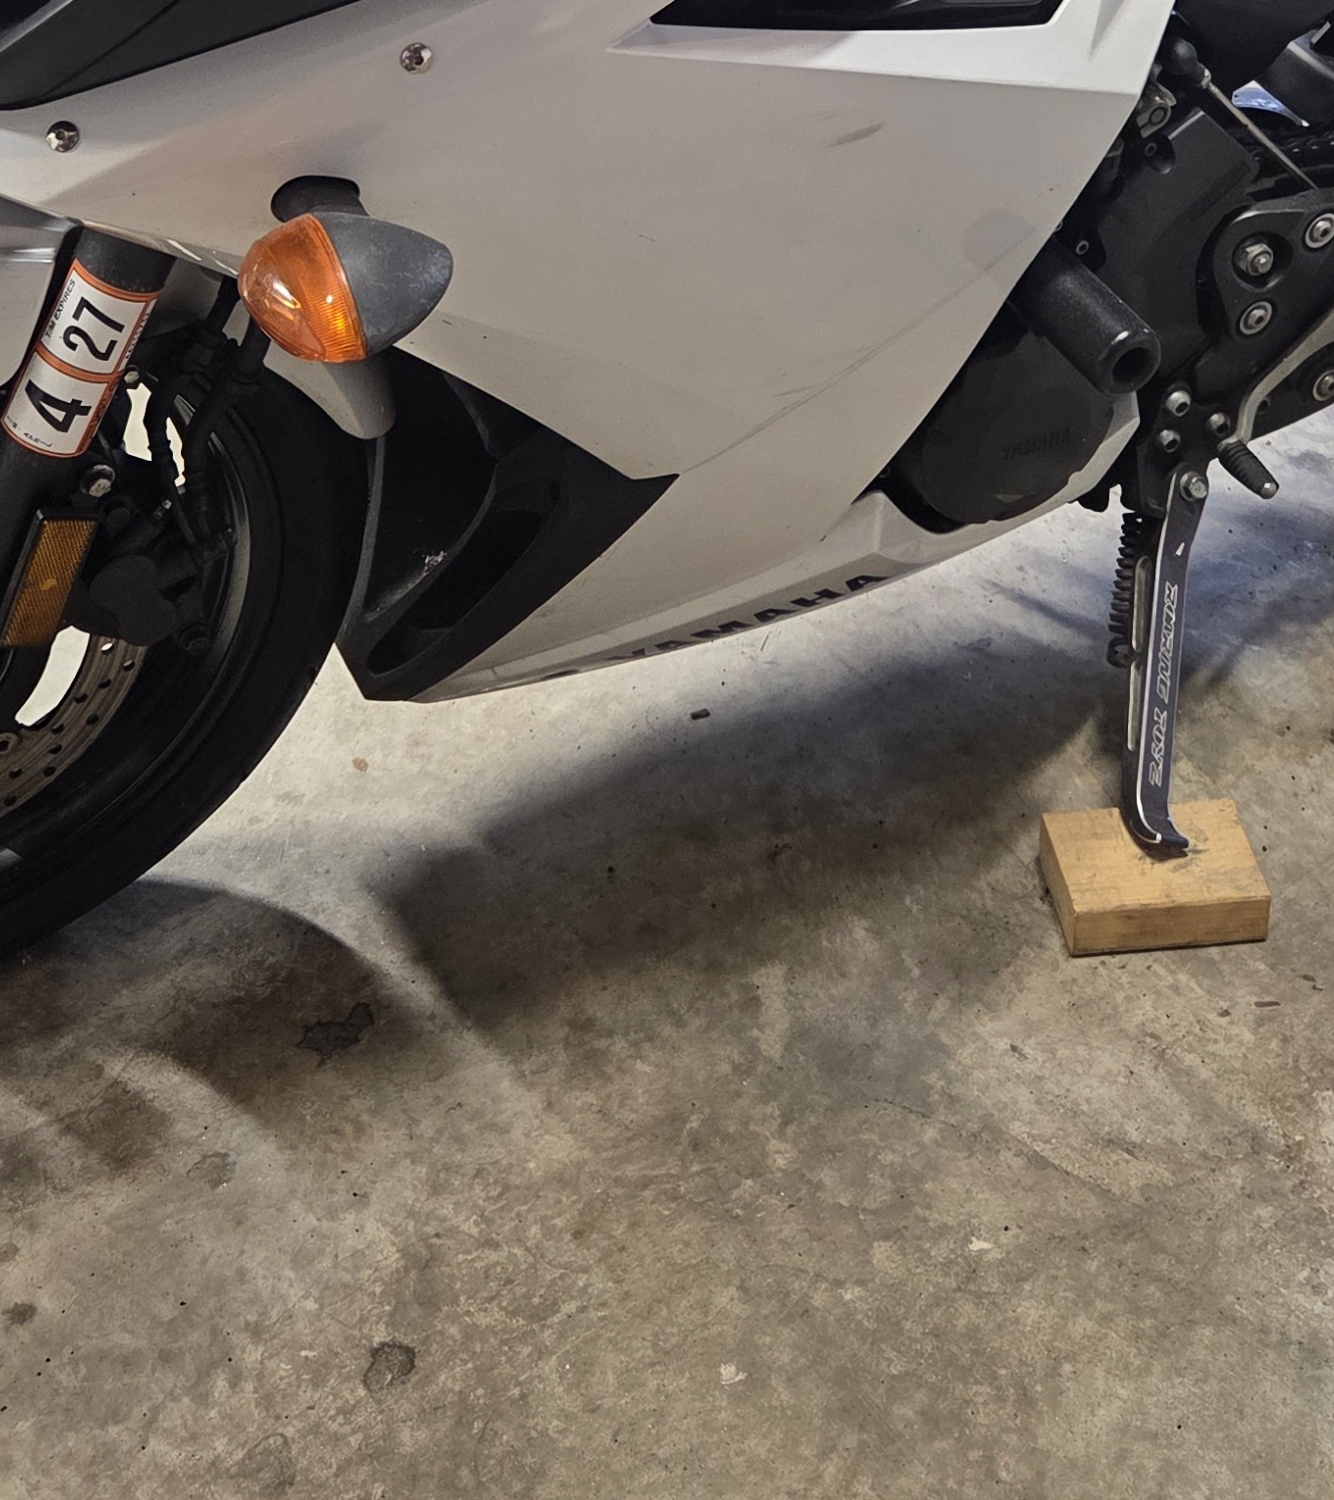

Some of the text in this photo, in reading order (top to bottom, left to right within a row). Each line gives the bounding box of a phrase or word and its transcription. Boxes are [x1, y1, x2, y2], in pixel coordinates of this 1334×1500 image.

[53, 279, 76, 320] EXPIRES
[62, 296, 126, 362] 27
[25, 378, 93, 434] 4
[604, 574, 891, 661] YAMAHA
